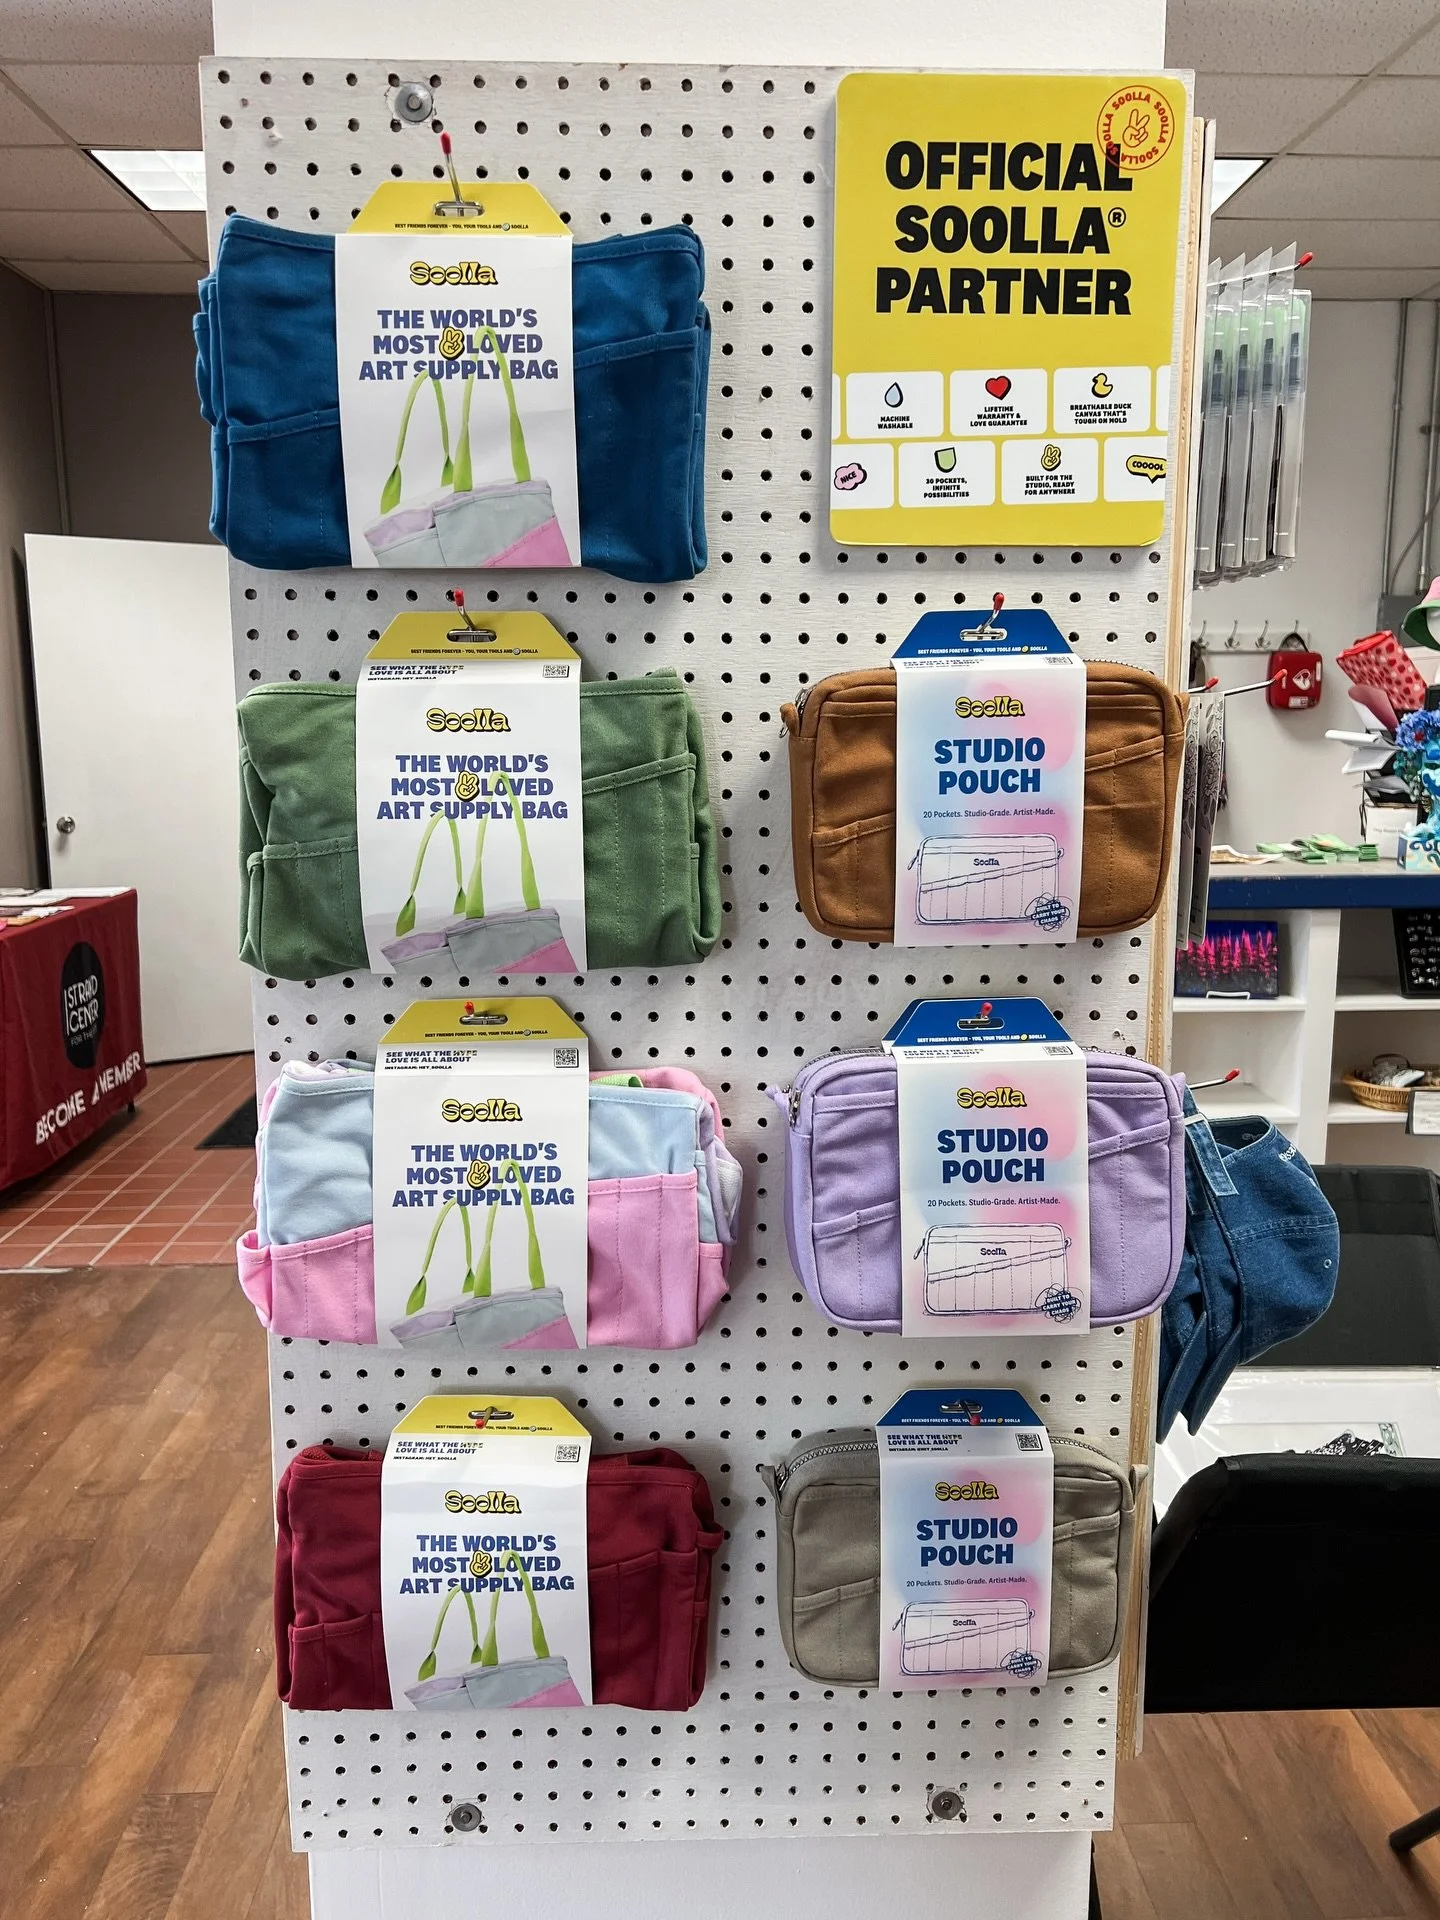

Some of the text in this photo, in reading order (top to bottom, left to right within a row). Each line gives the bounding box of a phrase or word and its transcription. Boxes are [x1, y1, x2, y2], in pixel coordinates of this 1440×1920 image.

[1112, 91, 1151, 110] SOOLLA
[1154, 101, 1169, 143] SOOLLA
[1121, 146, 1159, 164] SOOLLA
[885, 141, 1133, 191] OFFICIAL
[410, 261, 498, 286] Soolla
[876, 266, 1132, 316] PARTNER
[377, 308, 537, 329] THE WORLD'S
[373, 334, 543, 354] MOST LOVED
[359, 360, 558, 380] ART SUPPLY BAG
[840, 471, 857, 484] NICE
[955, 696, 1025, 718] Soolla
[427, 708, 511, 732] Soolla
[935, 737, 1045, 764] STUDIO
[396, 754, 549, 772] THE WORLD'S
[391, 778, 553, 796] MOST LOVED
[939, 768, 1040, 795] POUCH
[377, 802, 568, 820] ART SUPPLY BAG
[923, 808, 1055, 819] 20 Pockets. Studio-Grade. Artist-Made.
[92, 1080, 100, 1105] A
[957, 1087, 1027, 1109] Soolla
[442, 1099, 523, 1122] Soolla
[937, 1128, 1049, 1154] STUDIO
[411, 1143, 557, 1162] THE WORLD'S
[406, 1166, 561, 1184] MOST LOVED
[943, 1158, 1044, 1183] POUCH
[392, 1188, 574, 1208] ART SUPPLY BAG
[969, 1198, 1016, 1207] Studio-Grade.
[1018, 1197, 1060, 1205] Artist-Made.
[935, 1482, 999, 1501] Soolla
[445, 1490, 522, 1514] Soolla
[916, 1517, 1018, 1541] STUDIO
[416, 1535, 556, 1551] THE WORLD'S
[413, 1556, 561, 1573] MOST LOVED
[921, 1544, 1013, 1567] POUCH
[400, 1576, 574, 1594] ART SUPPLY BAG
[944, 1578, 987, 1586] Studio-Grade.
